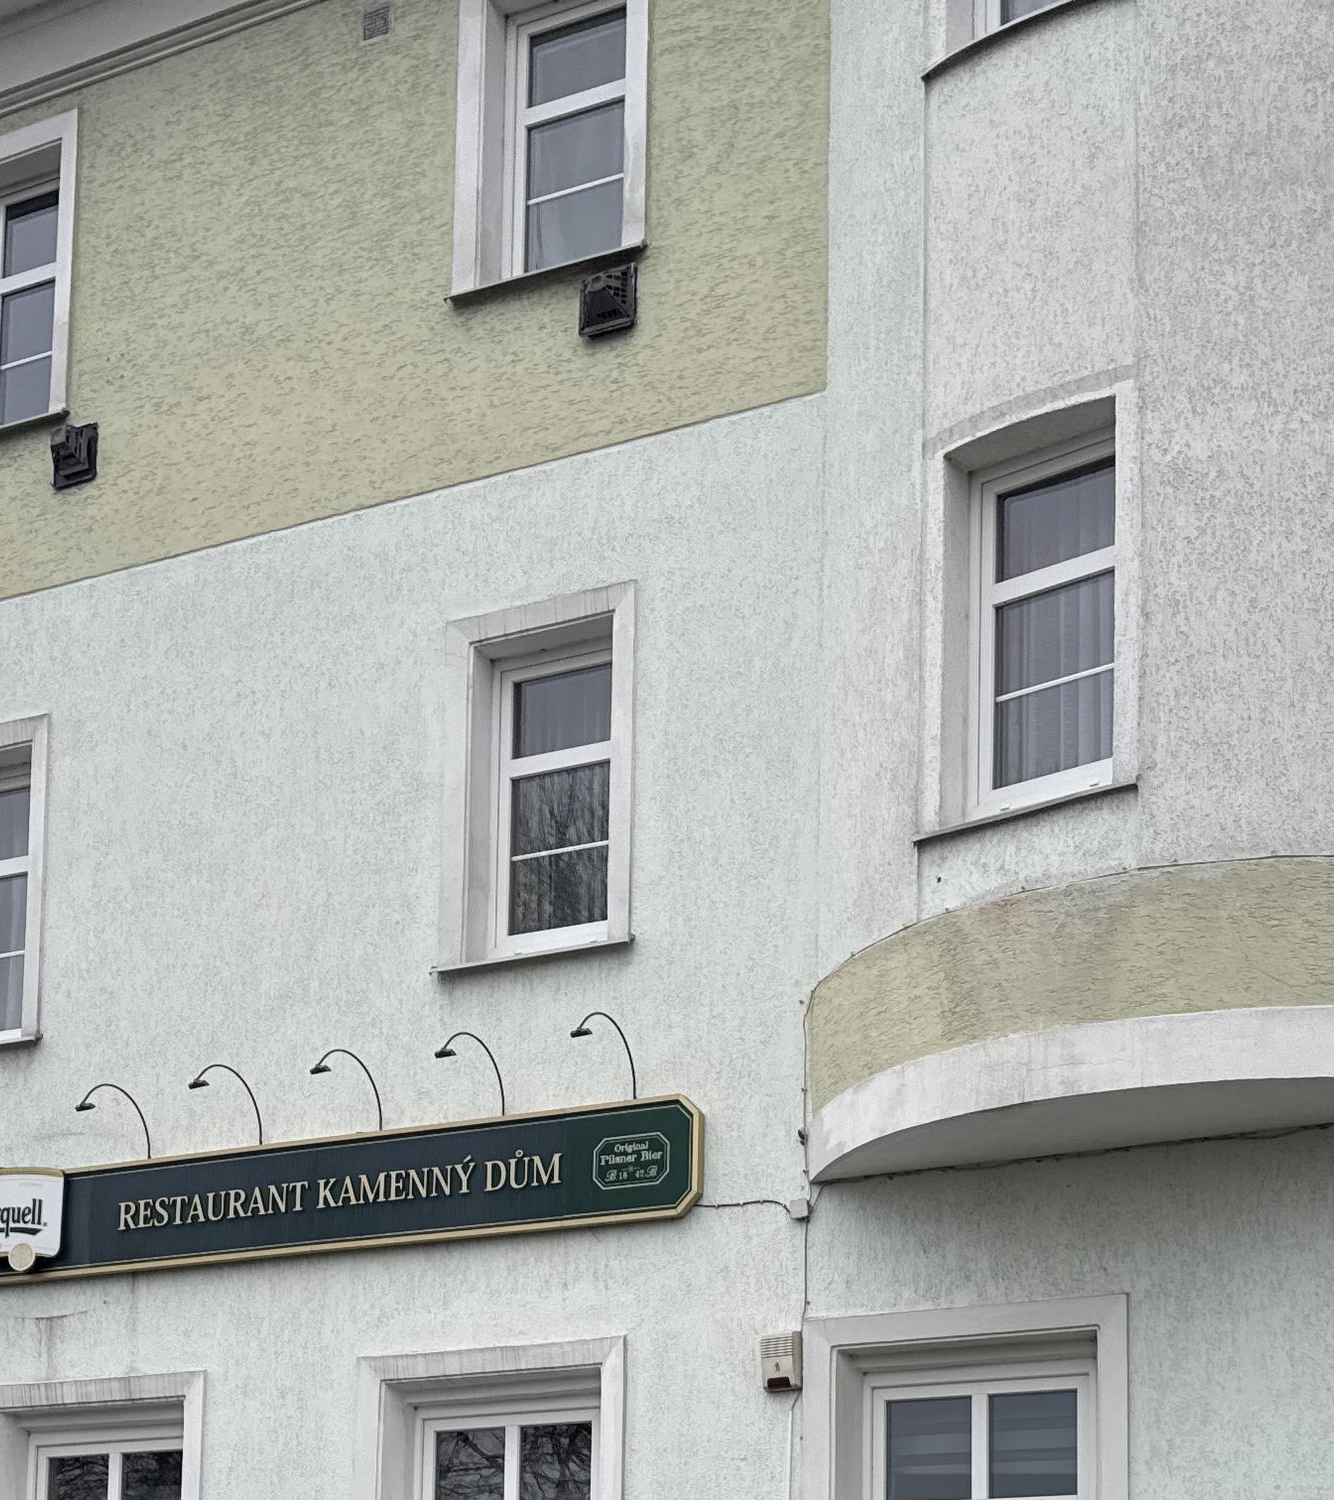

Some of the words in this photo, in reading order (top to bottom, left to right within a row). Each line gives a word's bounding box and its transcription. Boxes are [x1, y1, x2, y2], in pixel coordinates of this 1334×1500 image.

[614, 1141, 649, 1153] Original
[600, 1153, 637, 1165] Pilsner
[640, 1150, 663, 1161] Bier
[117, 1181, 309, 1231] RESTAURANT
[316, 1154, 476, 1209] KAMENNÝ
[484, 1149, 563, 1192] DŮM
